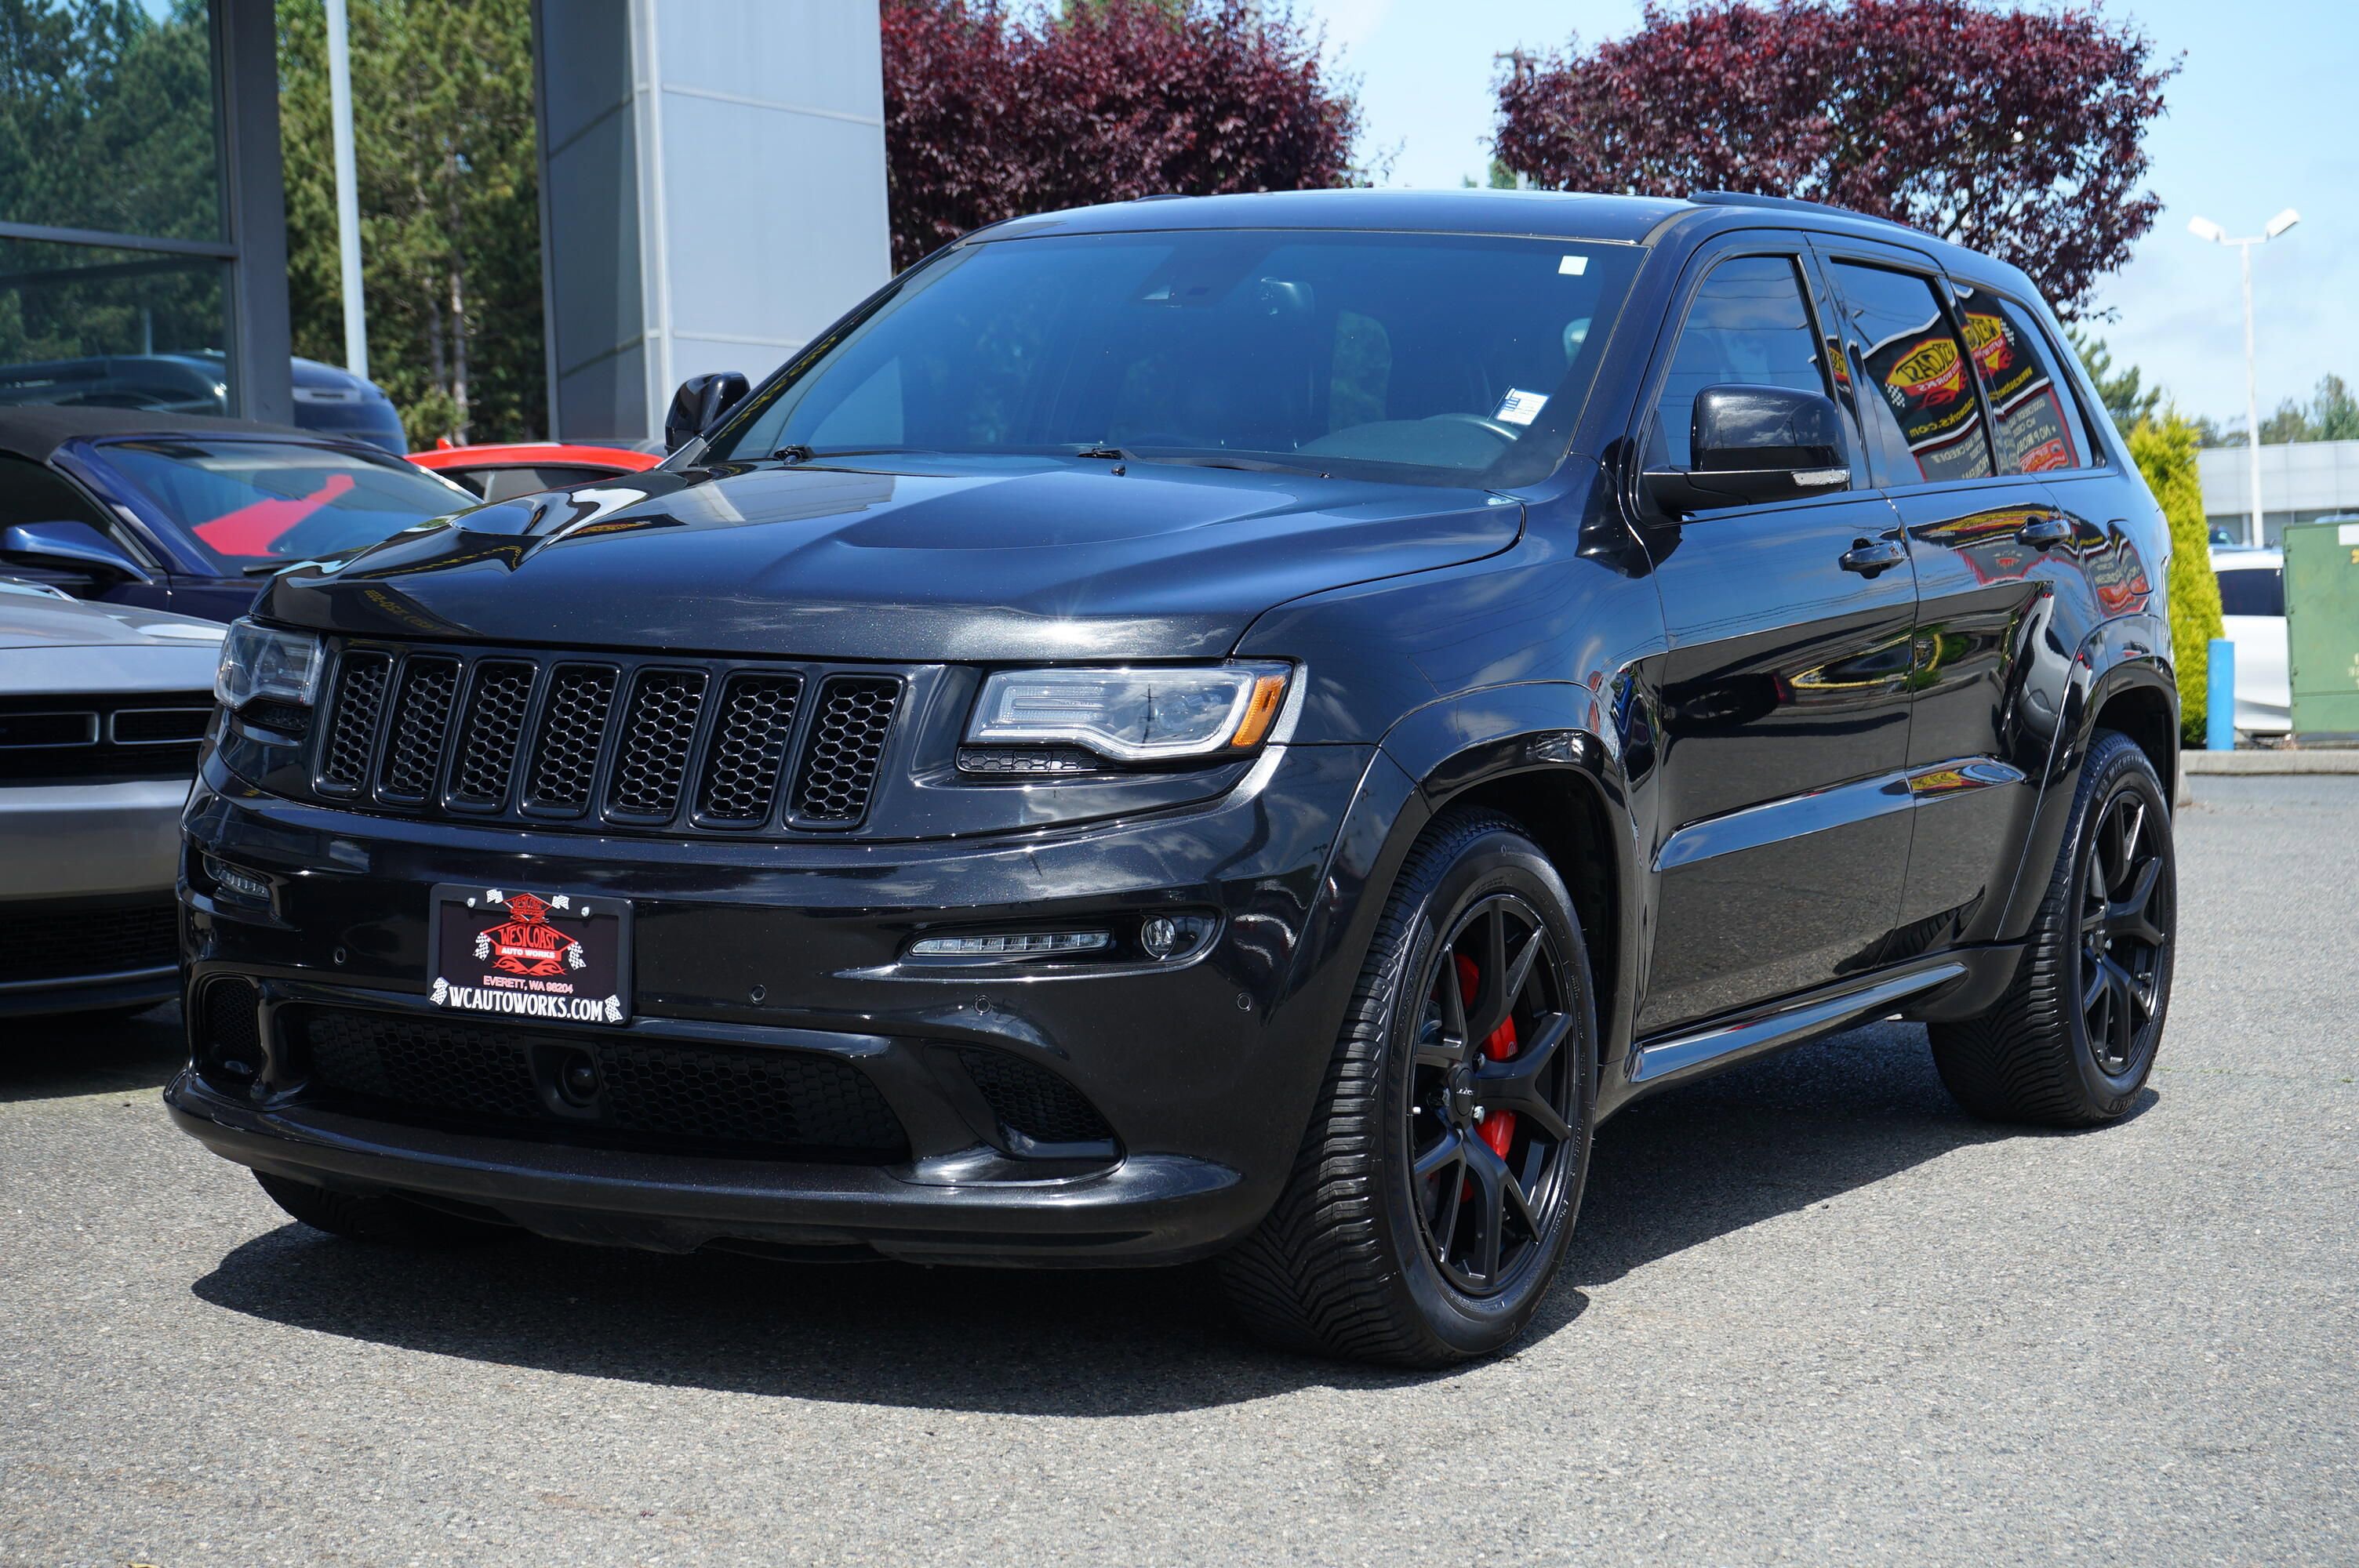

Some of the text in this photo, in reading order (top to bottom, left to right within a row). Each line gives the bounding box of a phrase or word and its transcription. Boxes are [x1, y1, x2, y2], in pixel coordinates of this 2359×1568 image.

[501, 946, 555, 959] AUTO WORKS
[483, 975, 573, 994] EVERETT, WA 98204
[449, 985, 603, 1022] WCAUTOWORKS.COM
